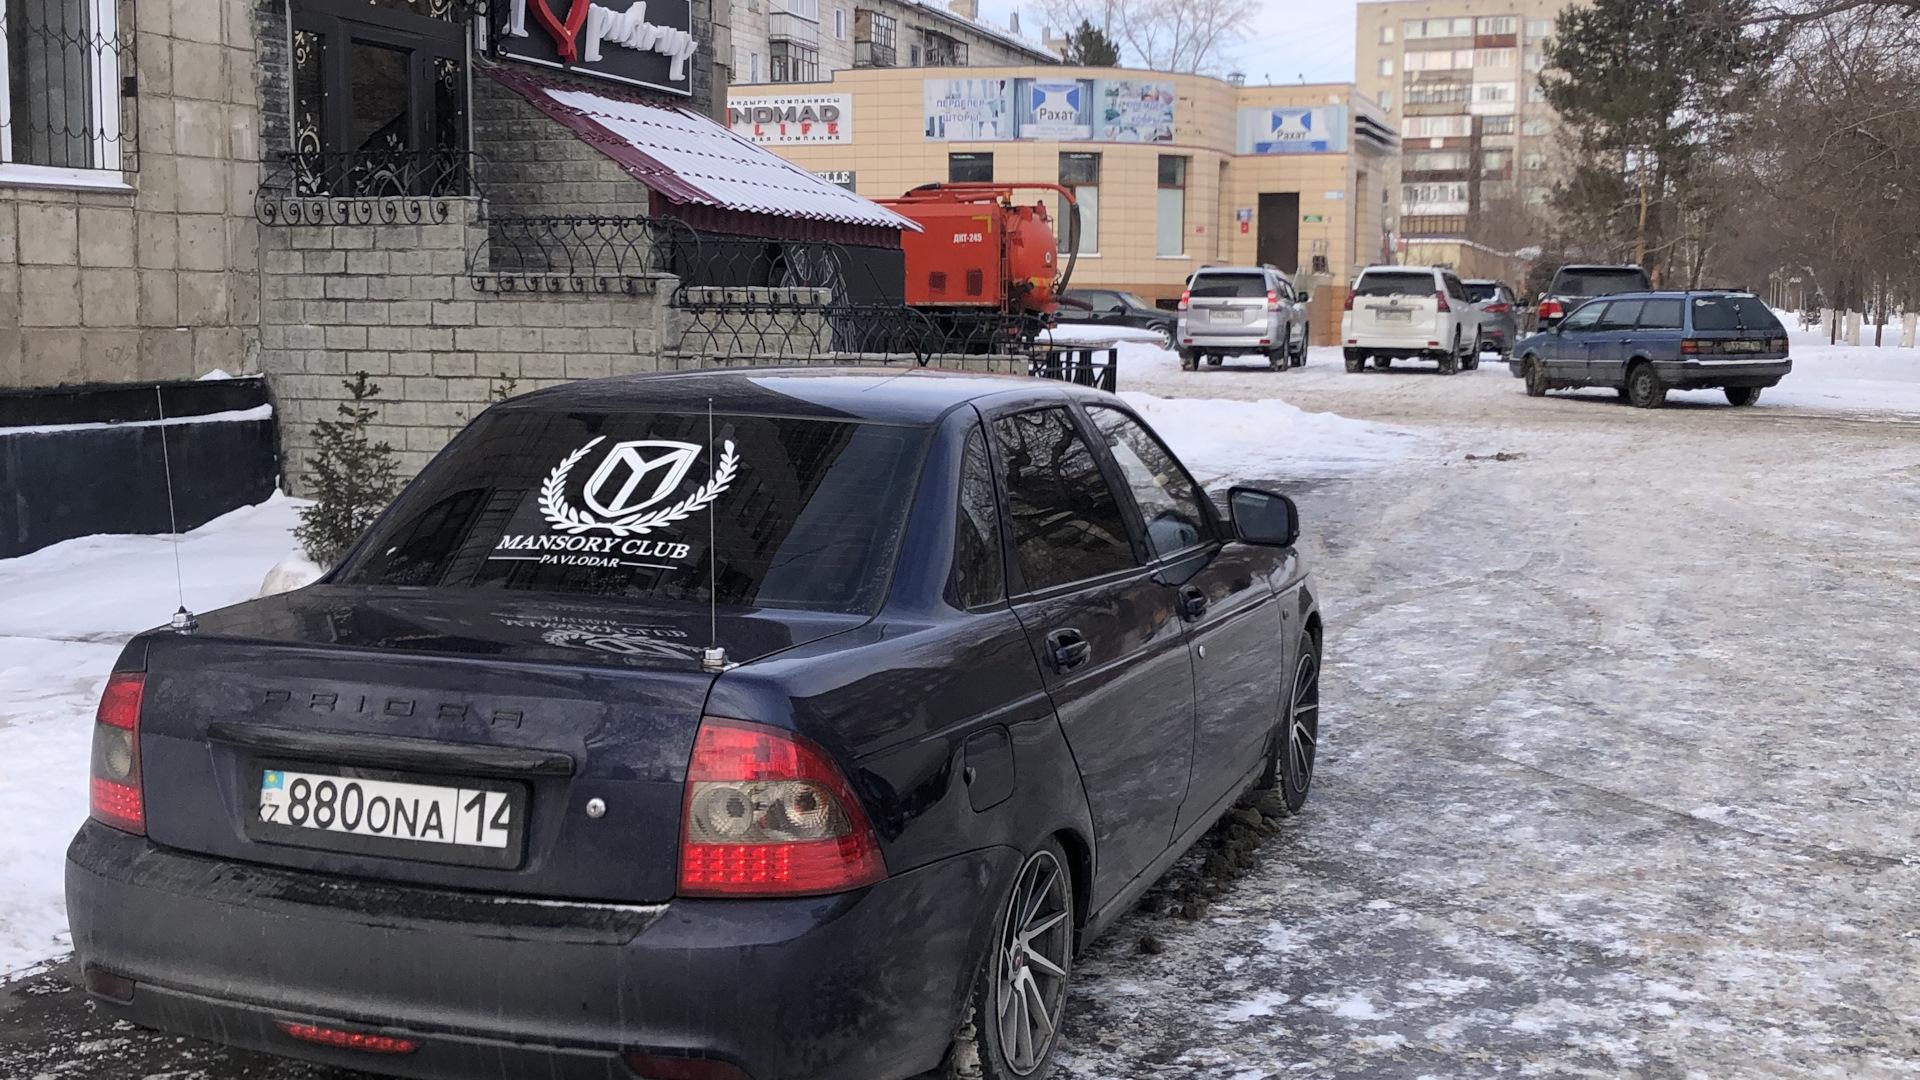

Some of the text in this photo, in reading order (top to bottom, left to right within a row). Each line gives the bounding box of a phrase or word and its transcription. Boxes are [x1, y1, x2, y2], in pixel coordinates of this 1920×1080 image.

[731, 105, 840, 124] NOMAD
[1039, 107, 1074, 121] Рахат
[754, 124, 839, 136] LIFE
[1277, 130, 1307, 140] Рахат
[816, 171, 850, 183] ELLE
[495, 534, 691, 560] MANSORY CLUB
[539, 555, 620, 569] PAVLODAR
[263, 690, 524, 730] PRIORA
[464, 792, 510, 842] 14
